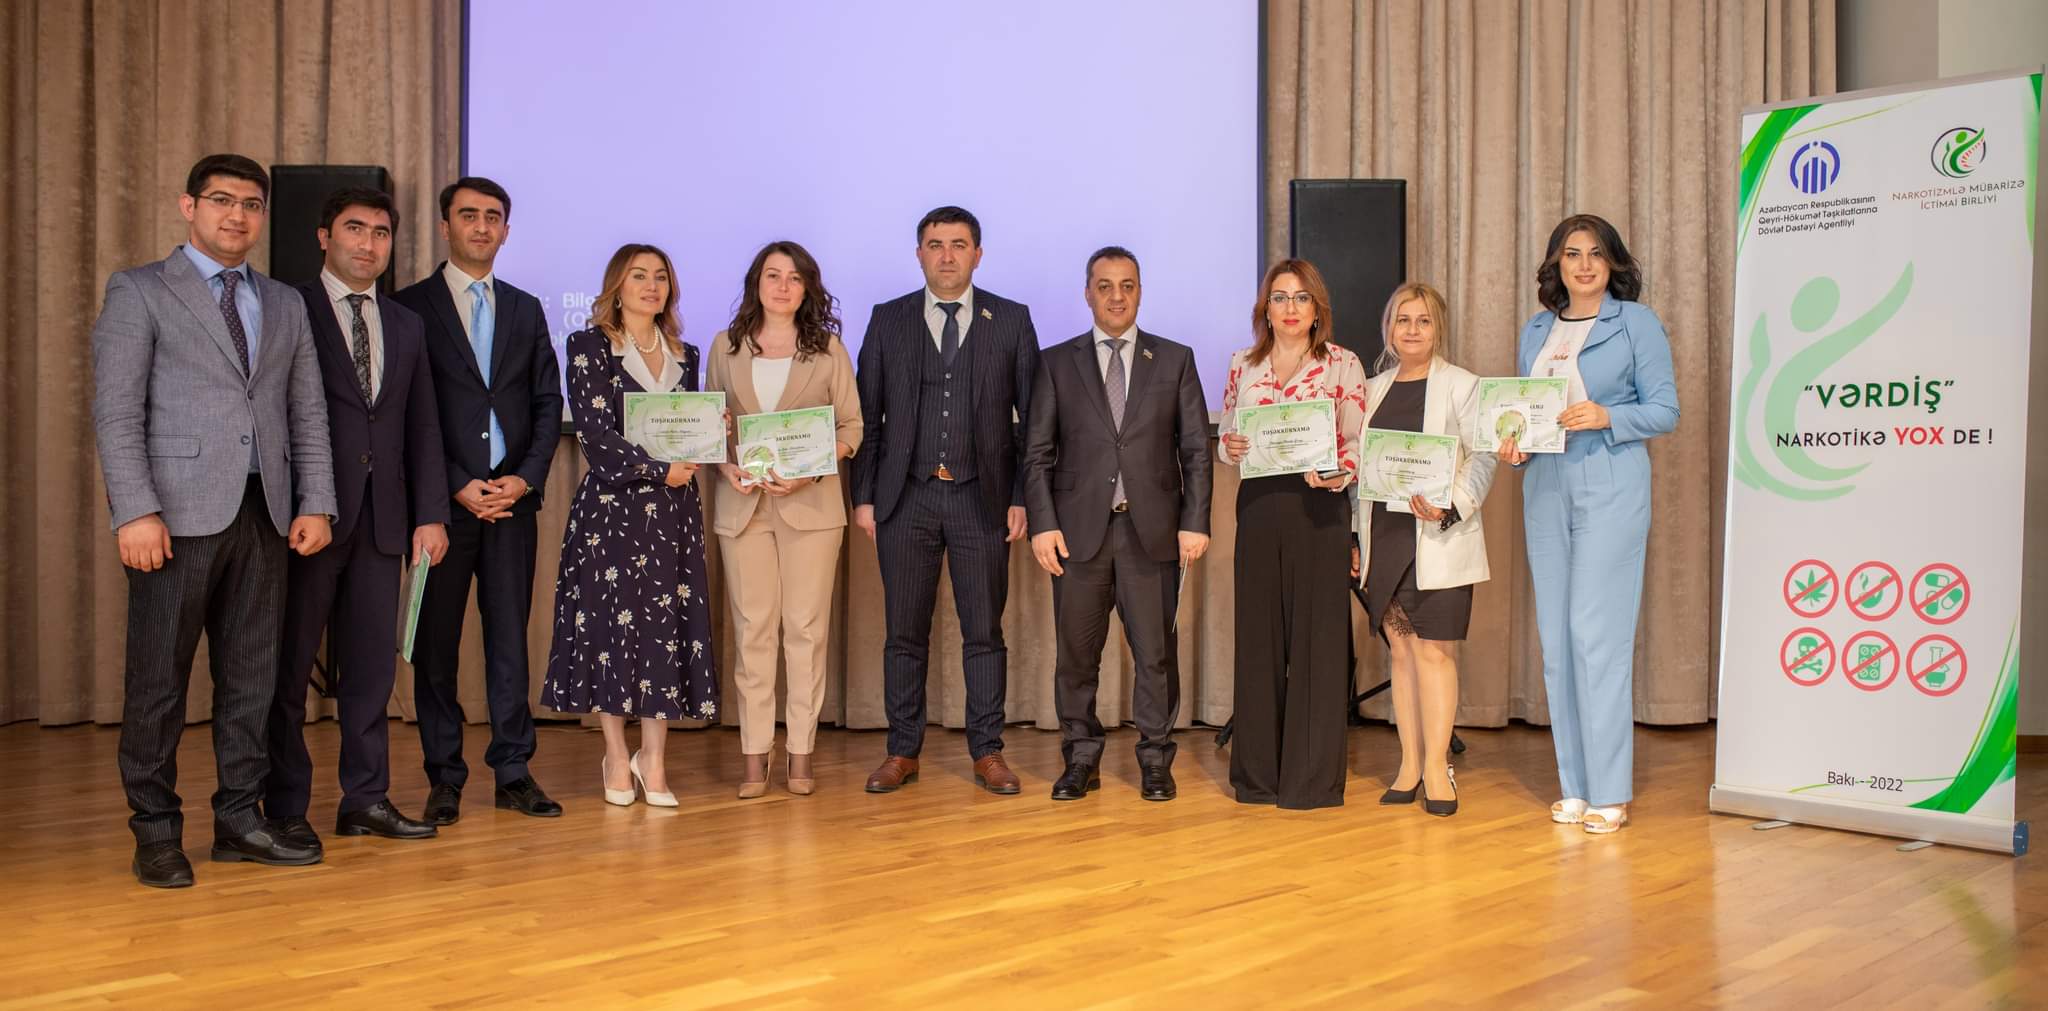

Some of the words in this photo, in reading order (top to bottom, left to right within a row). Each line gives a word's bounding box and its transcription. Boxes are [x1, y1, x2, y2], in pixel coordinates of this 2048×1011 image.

[1892, 186, 1966, 201] NARKOTİZMLƏ
[1969, 179, 2025, 193] MÜBARİZƏ
[1759, 202, 1809, 215] Azərbaycan
[1810, 195, 1876, 209] Respublikasının
[1822, 205, 1878, 219] Təşkilatlarına
[1758, 225, 1784, 235] Dövlət
[1785, 221, 1816, 233] Dəstəyi
[1776, 428, 1886, 447] NARKOTİKƏ
[1894, 426, 1945, 446] YOX
[1953, 429, 1981, 445] DE
[1827, 771, 1855, 787] Bakı
[1869, 775, 1903, 793] 2022
